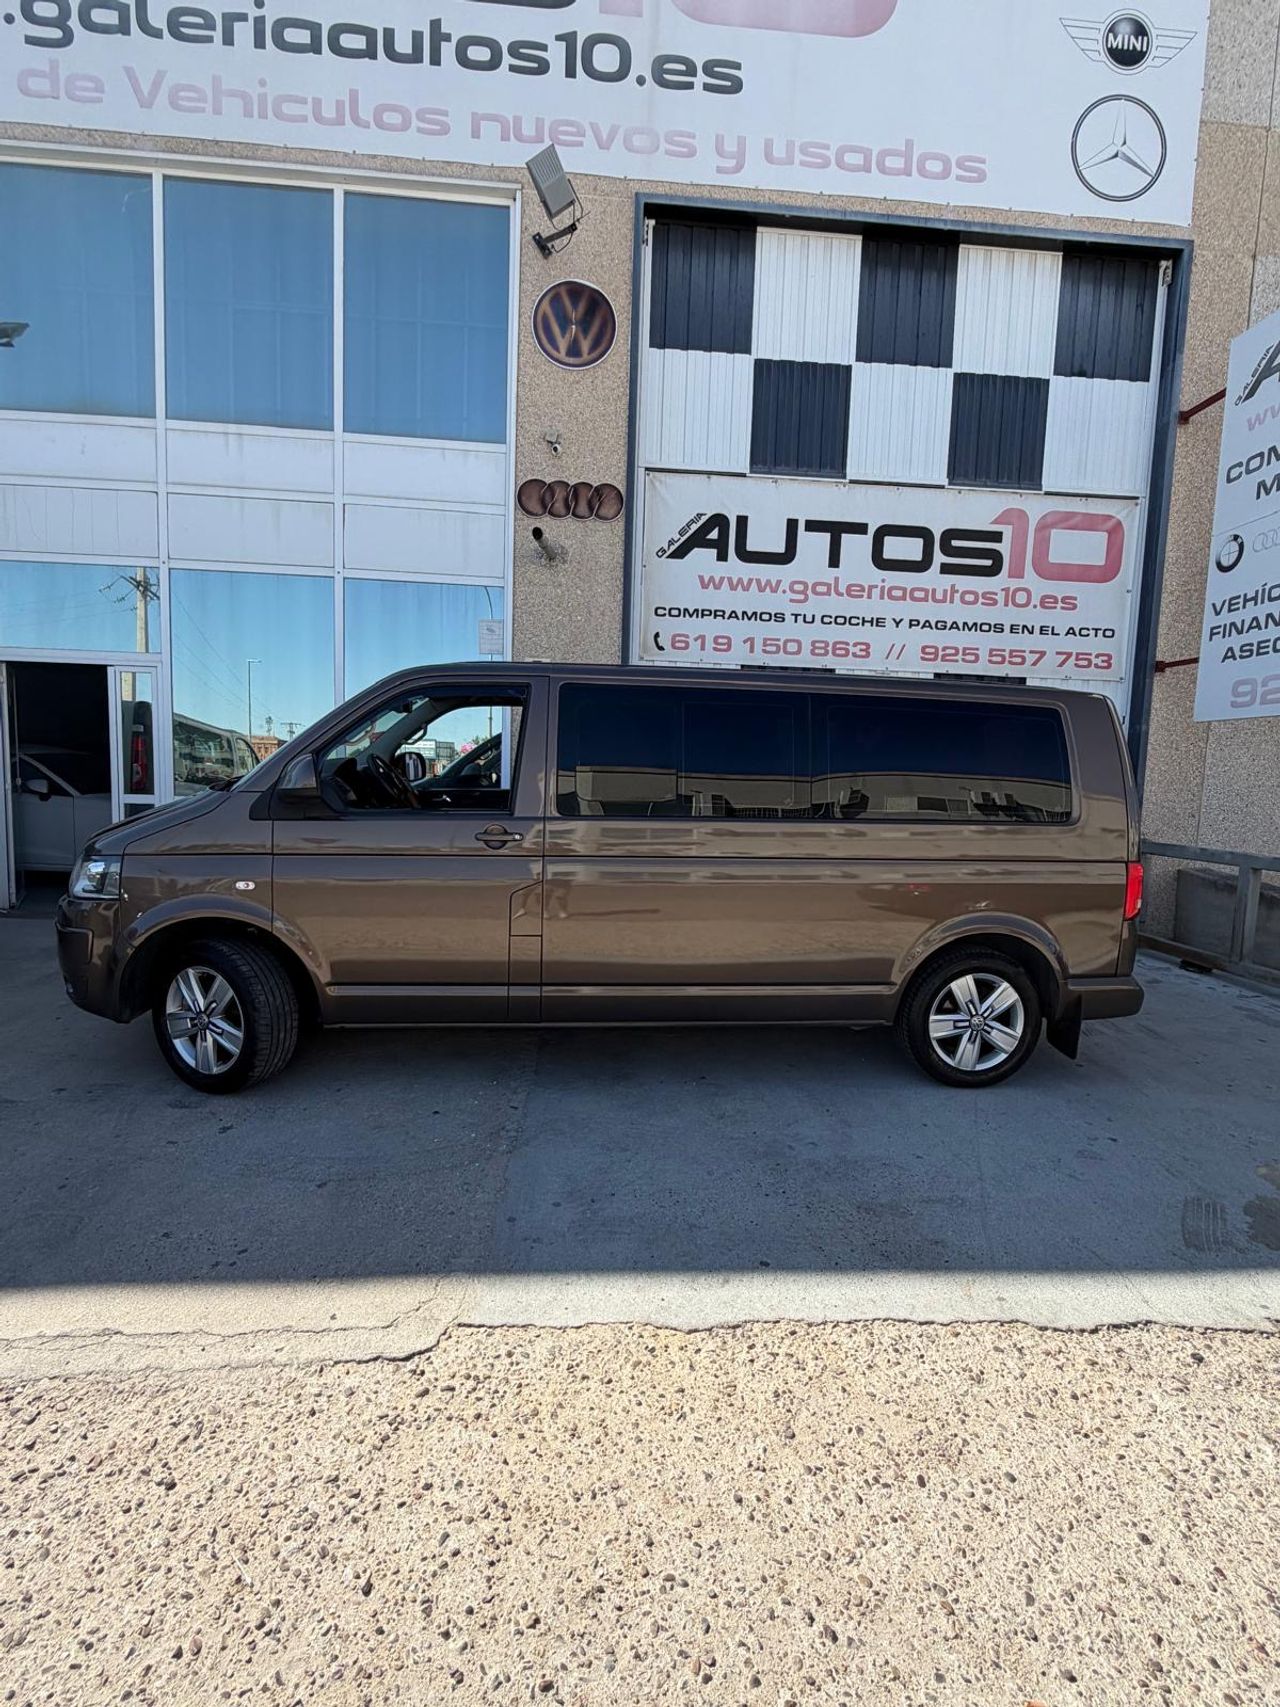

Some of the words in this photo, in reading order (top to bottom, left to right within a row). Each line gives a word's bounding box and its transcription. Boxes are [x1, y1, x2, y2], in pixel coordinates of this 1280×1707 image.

[1107, 32, 1148, 52] MINI
[17, 58, 105, 103] de
[122, 65, 451, 137] Vehiculos
[470, 111, 697, 159] nuevos
[714, 133, 747, 175] y
[763, 138, 988, 184] usados
[655, 512, 708, 559] GALERIA
[698, 575, 1078, 611] www.galeriaautos10.es
[654, 606, 786, 623] COMPRAMOS
[791, 613, 816, 625] TU
[820, 615, 887, 628] COCHE
[892, 617, 904, 629] Y
[908, 618, 1005, 634] PAGAMOS
[1009, 623, 1035, 635] EN
[1039, 625, 1061, 636] EL
[1065, 626, 1116, 639] ACTO
[670, 633, 733, 653] 619
[742, 636, 803, 656] 150
[809, 639, 871, 660] 863
[920, 644, 980, 664] 925
[987, 647, 1047, 667] 557
[1055, 651, 1113, 670] 753
